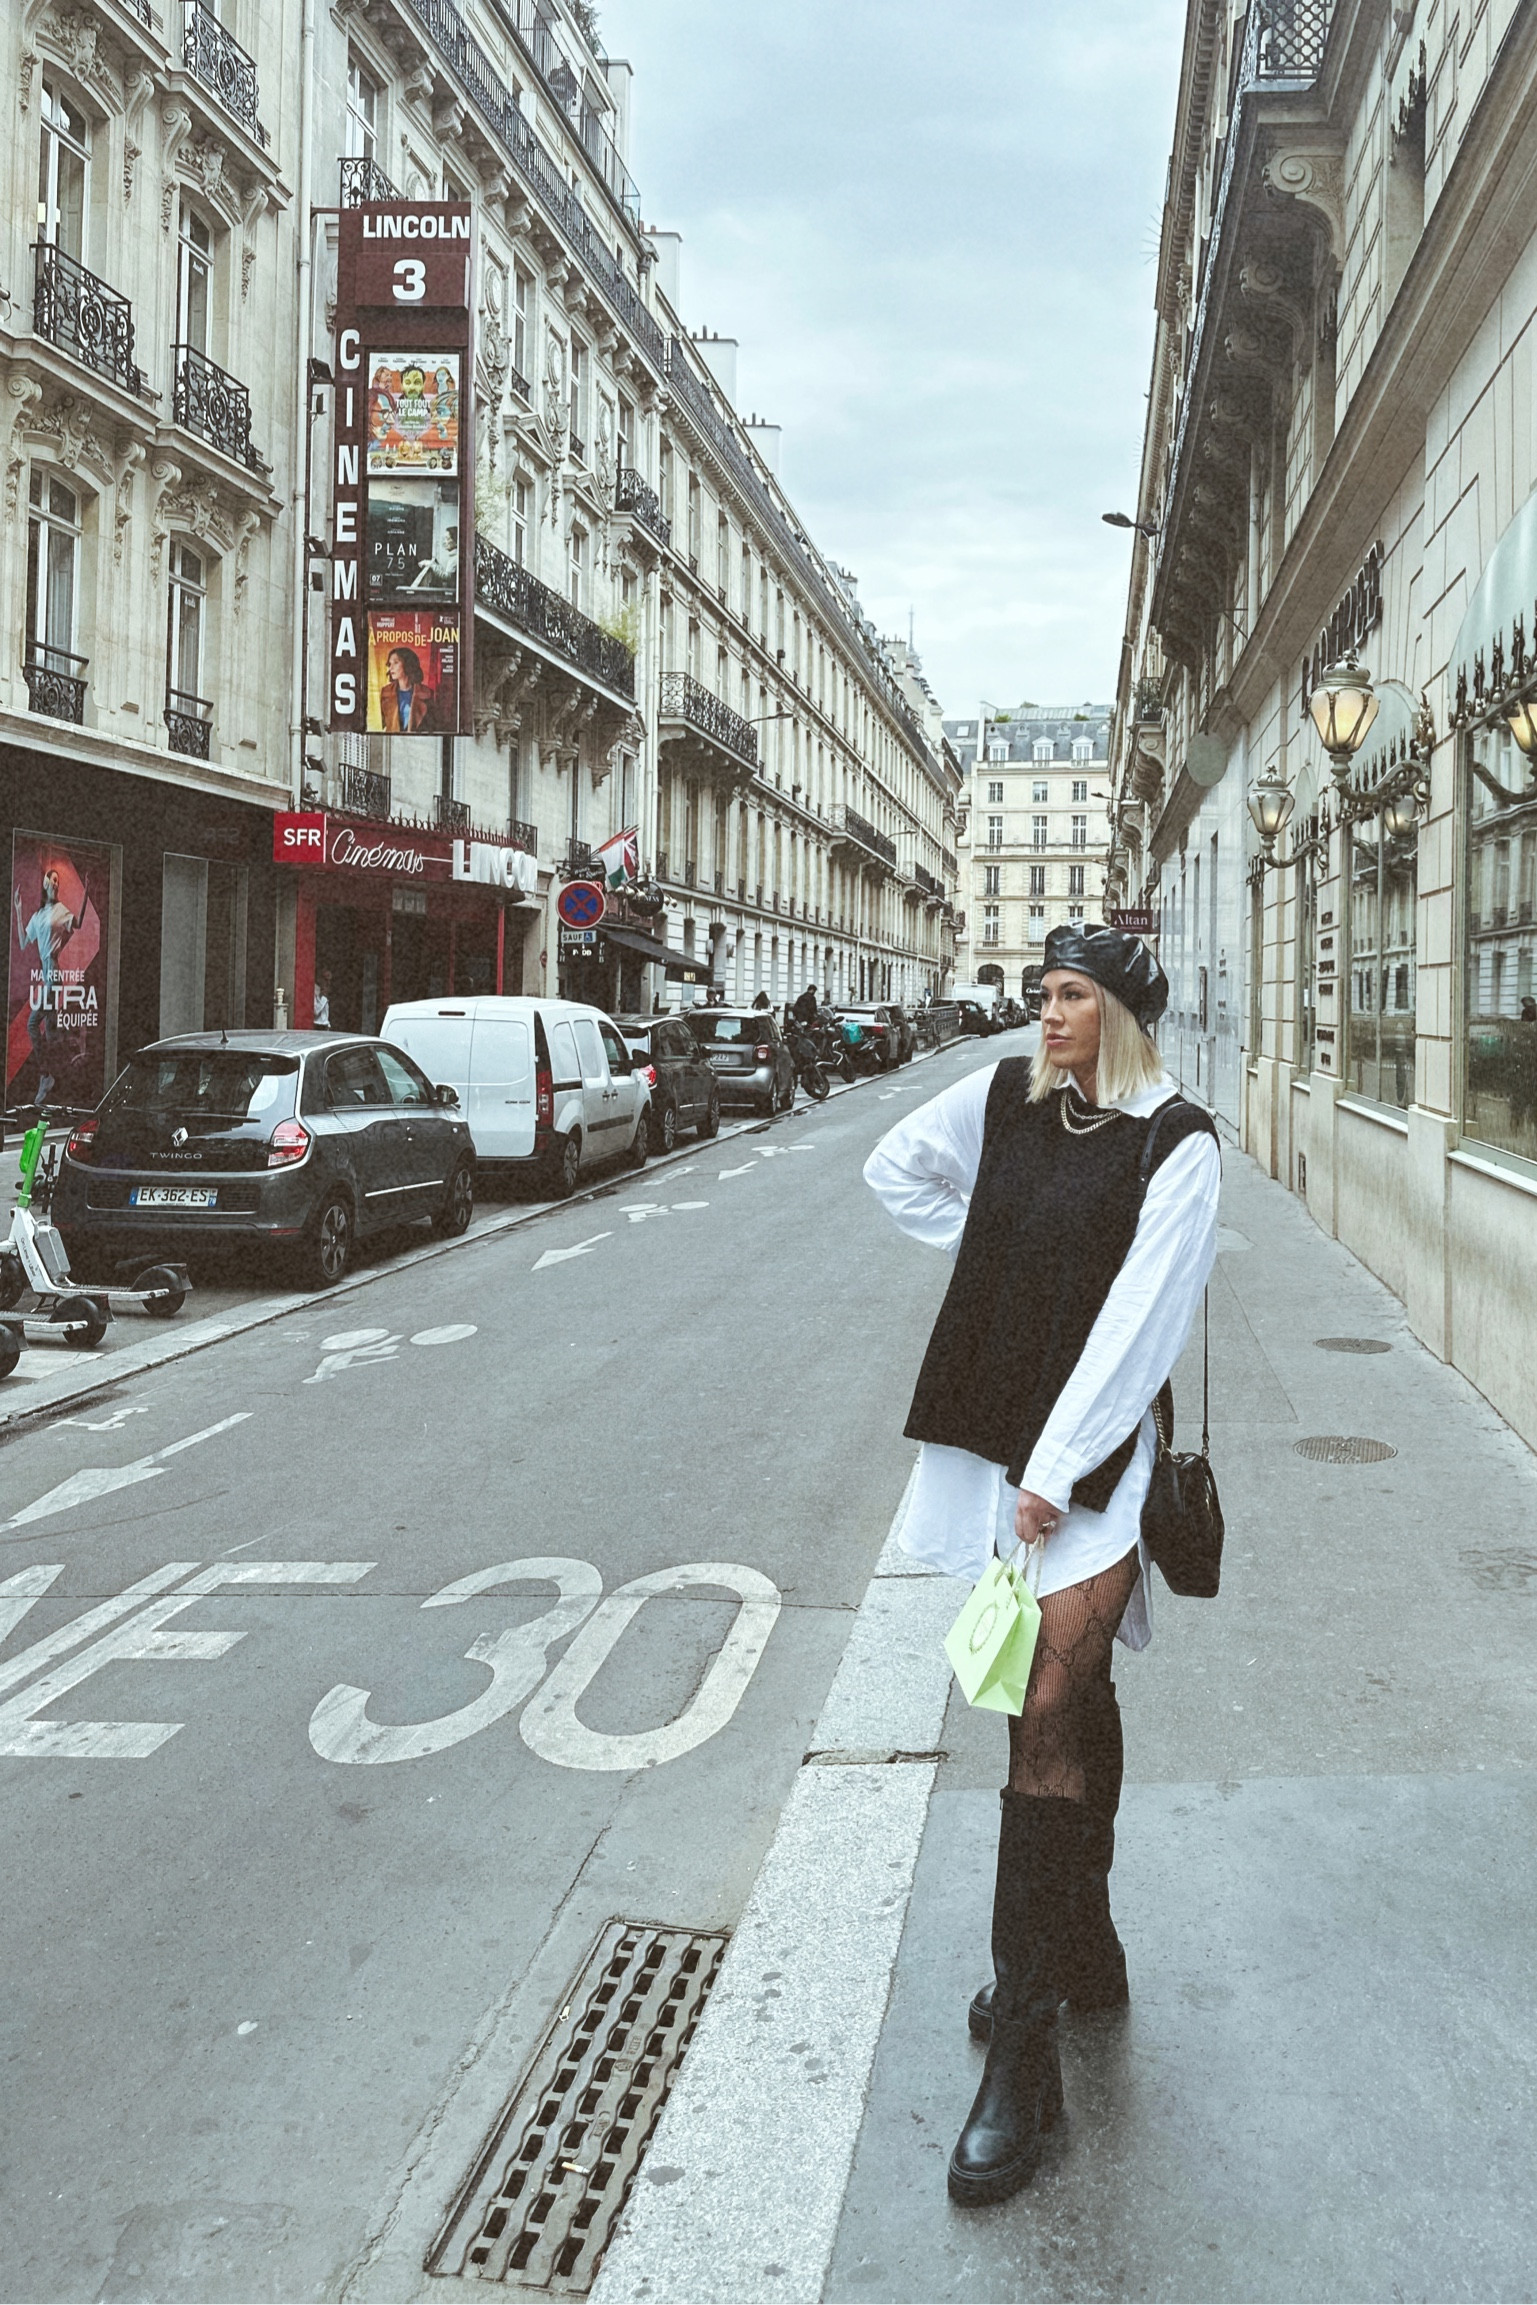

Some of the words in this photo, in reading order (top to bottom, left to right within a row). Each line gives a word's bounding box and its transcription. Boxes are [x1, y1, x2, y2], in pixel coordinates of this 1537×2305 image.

[363, 215, 470, 239] LINCOLN
[392, 259, 426, 300] 3
[396, 399, 413, 408] TOUT
[414, 399, 431, 408] FOUT
[398, 408, 406, 416] LE
[408, 408, 428, 417] CAMP
[334, 329, 361, 715] CINEMAS
[374, 543, 417, 556] PLAN
[386, 557, 405, 570] 75
[376, 631, 414, 643] PROPOS
[414, 635, 427, 647] DE
[427, 627, 459, 643] JOAN
[283, 828, 321, 846] SFR
[1114, 914, 1148, 926] Altan
[30, 969, 44, 982] MA
[47, 967, 85, 982] RENTRÉE
[29, 985, 98, 1011] ULTRA
[56, 1009, 98, 1030] ÉQUIPÉE
[149, 1151, 203, 1160] TWINGO
[139, 1187, 209, 1203] EK-362-ES
[308, 1556, 783, 1771] 30
